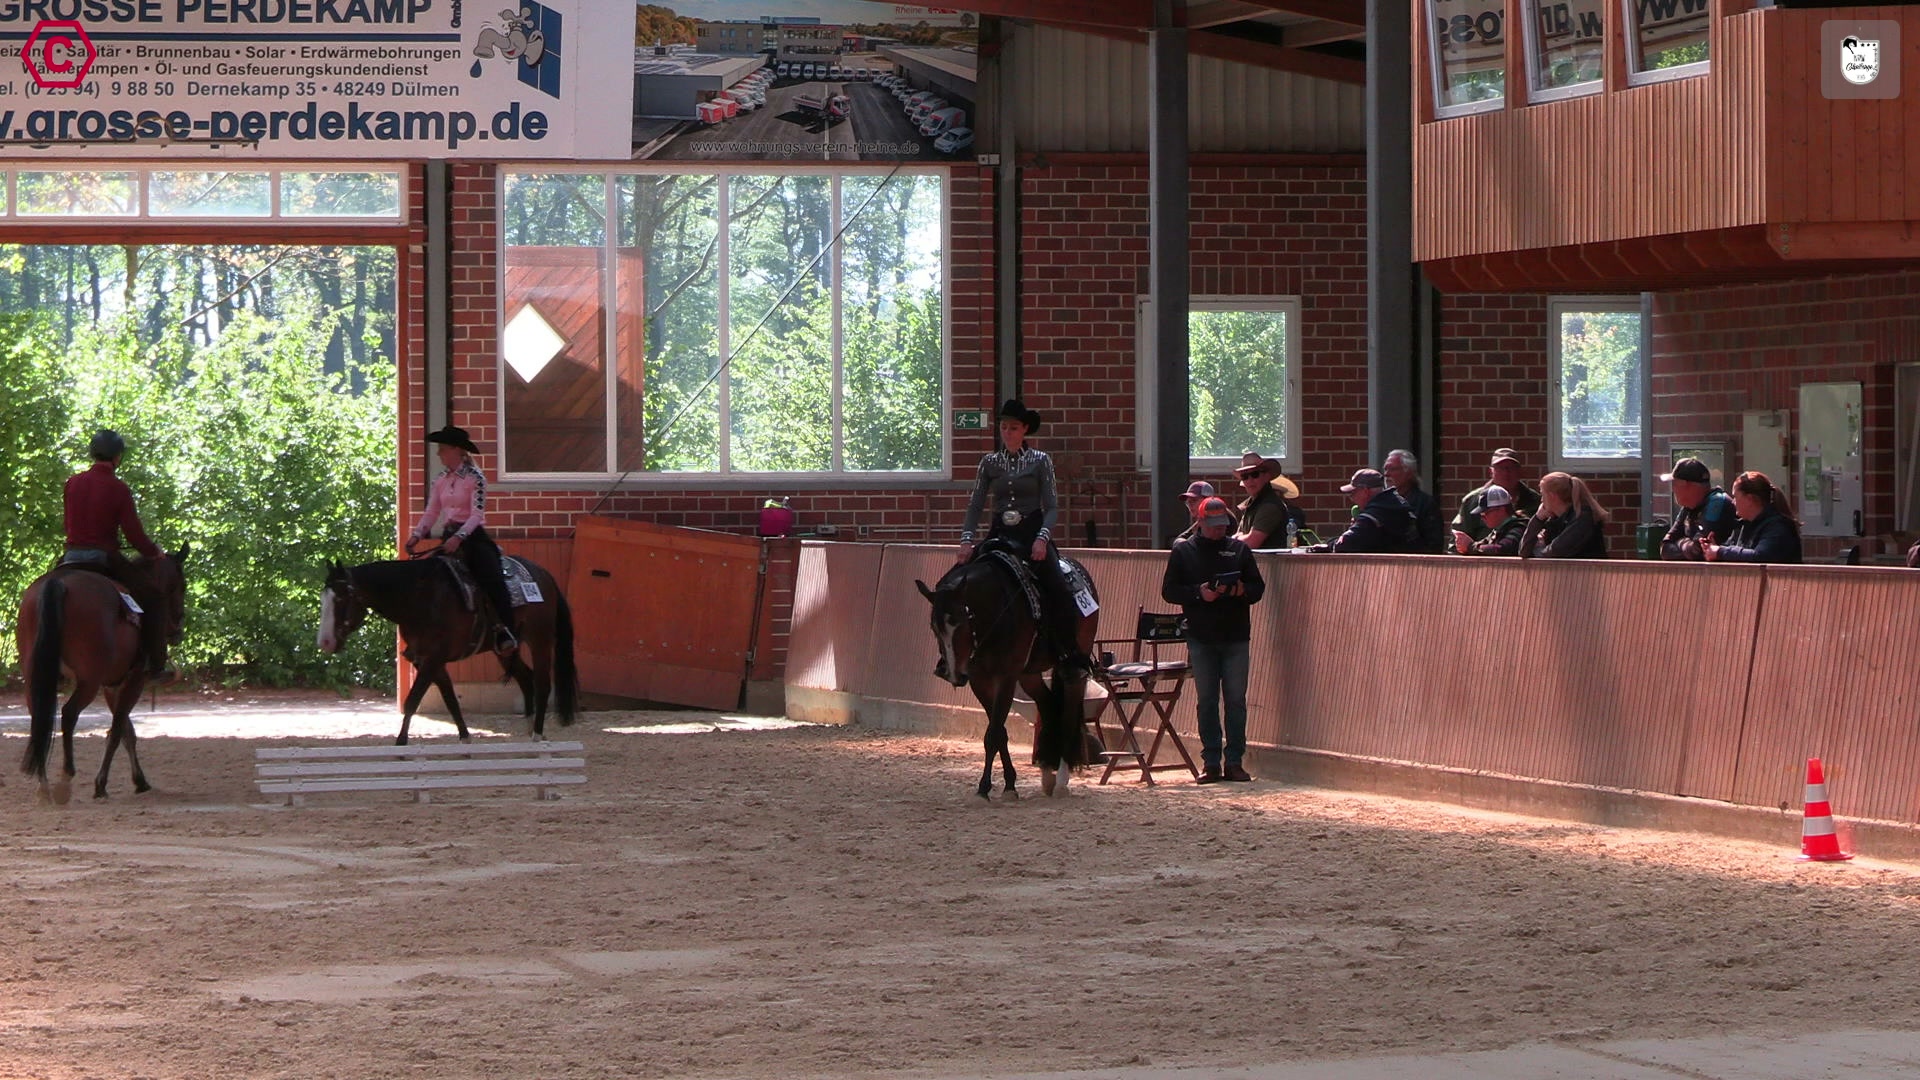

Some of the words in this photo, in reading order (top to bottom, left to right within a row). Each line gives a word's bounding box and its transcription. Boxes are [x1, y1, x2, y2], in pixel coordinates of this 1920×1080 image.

[0, 0, 163, 23] GROSSE
[176, 0, 431, 24] PERDEKAMP
[0, 46, 48, 61] eizn
[66, 45, 121, 58] Saitär
[136, 45, 231, 59] Brunnenbau
[246, 45, 286, 59] Solar
[300, 46, 462, 61] Erdwärmebohrungen
[22, 62, 138, 77] Wärepumpen
[155, 62, 178, 75] Öl-
[182, 63, 211, 76] und
[216, 63, 429, 78] Gasfeuerungskundendienst
[111, 82, 121, 96] 9
[127, 82, 148, 96] 88
[154, 82, 174, 96] 50
[188, 82, 290, 99] Dernekamp
[295, 82, 317, 96] 35
[334, 82, 386, 97] 48249
[392, 82, 460, 97] Dülmen
